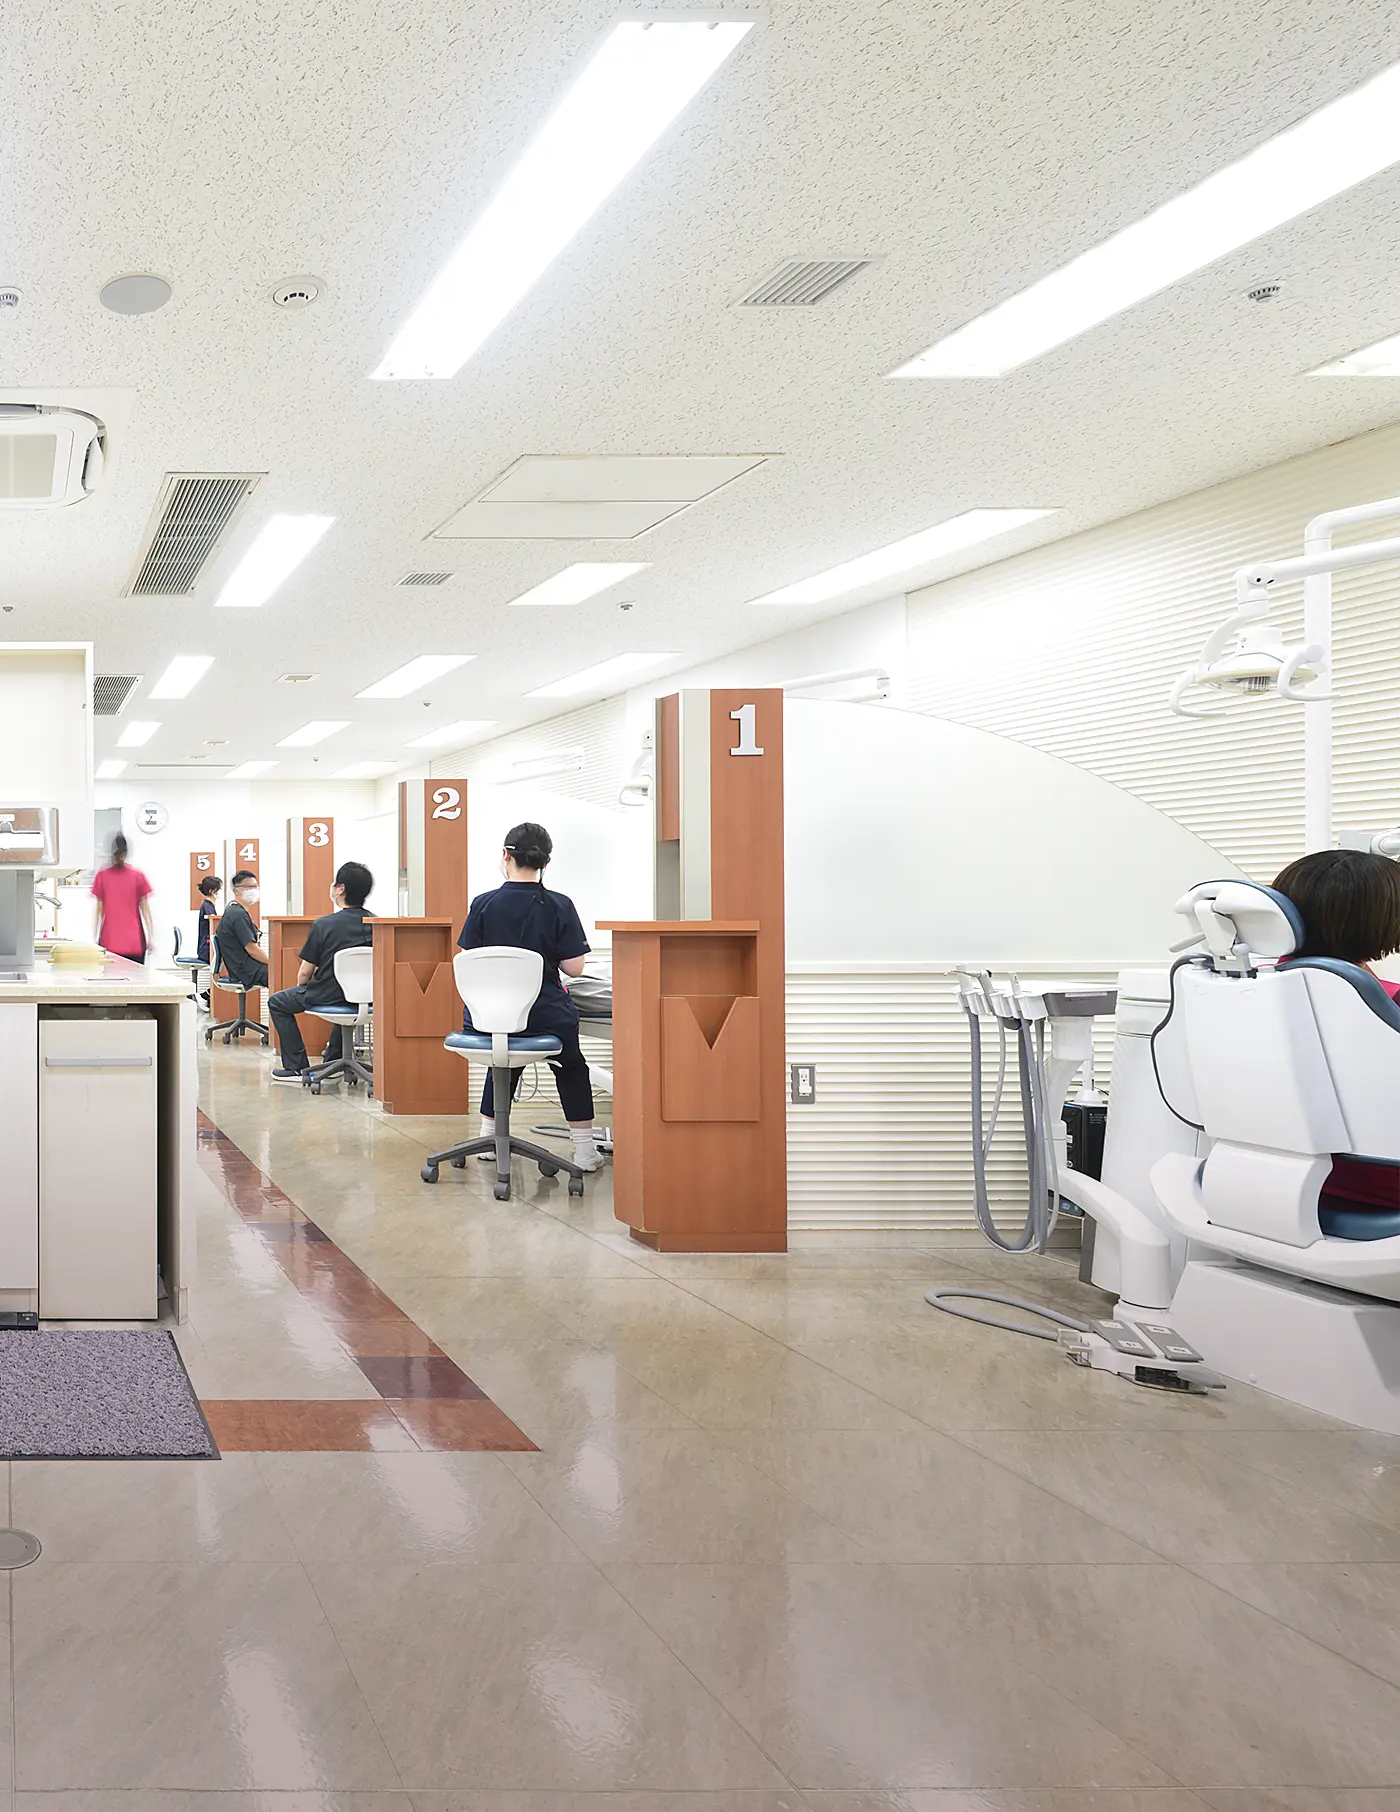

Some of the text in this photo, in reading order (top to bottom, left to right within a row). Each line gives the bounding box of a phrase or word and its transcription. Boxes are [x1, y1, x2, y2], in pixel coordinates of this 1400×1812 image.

[730, 704, 764, 757] 1
[432, 787, 461, 820] 2
[308, 822, 330, 847] 3
[197, 854, 211, 871] 5
[239, 843, 257, 862] 4
